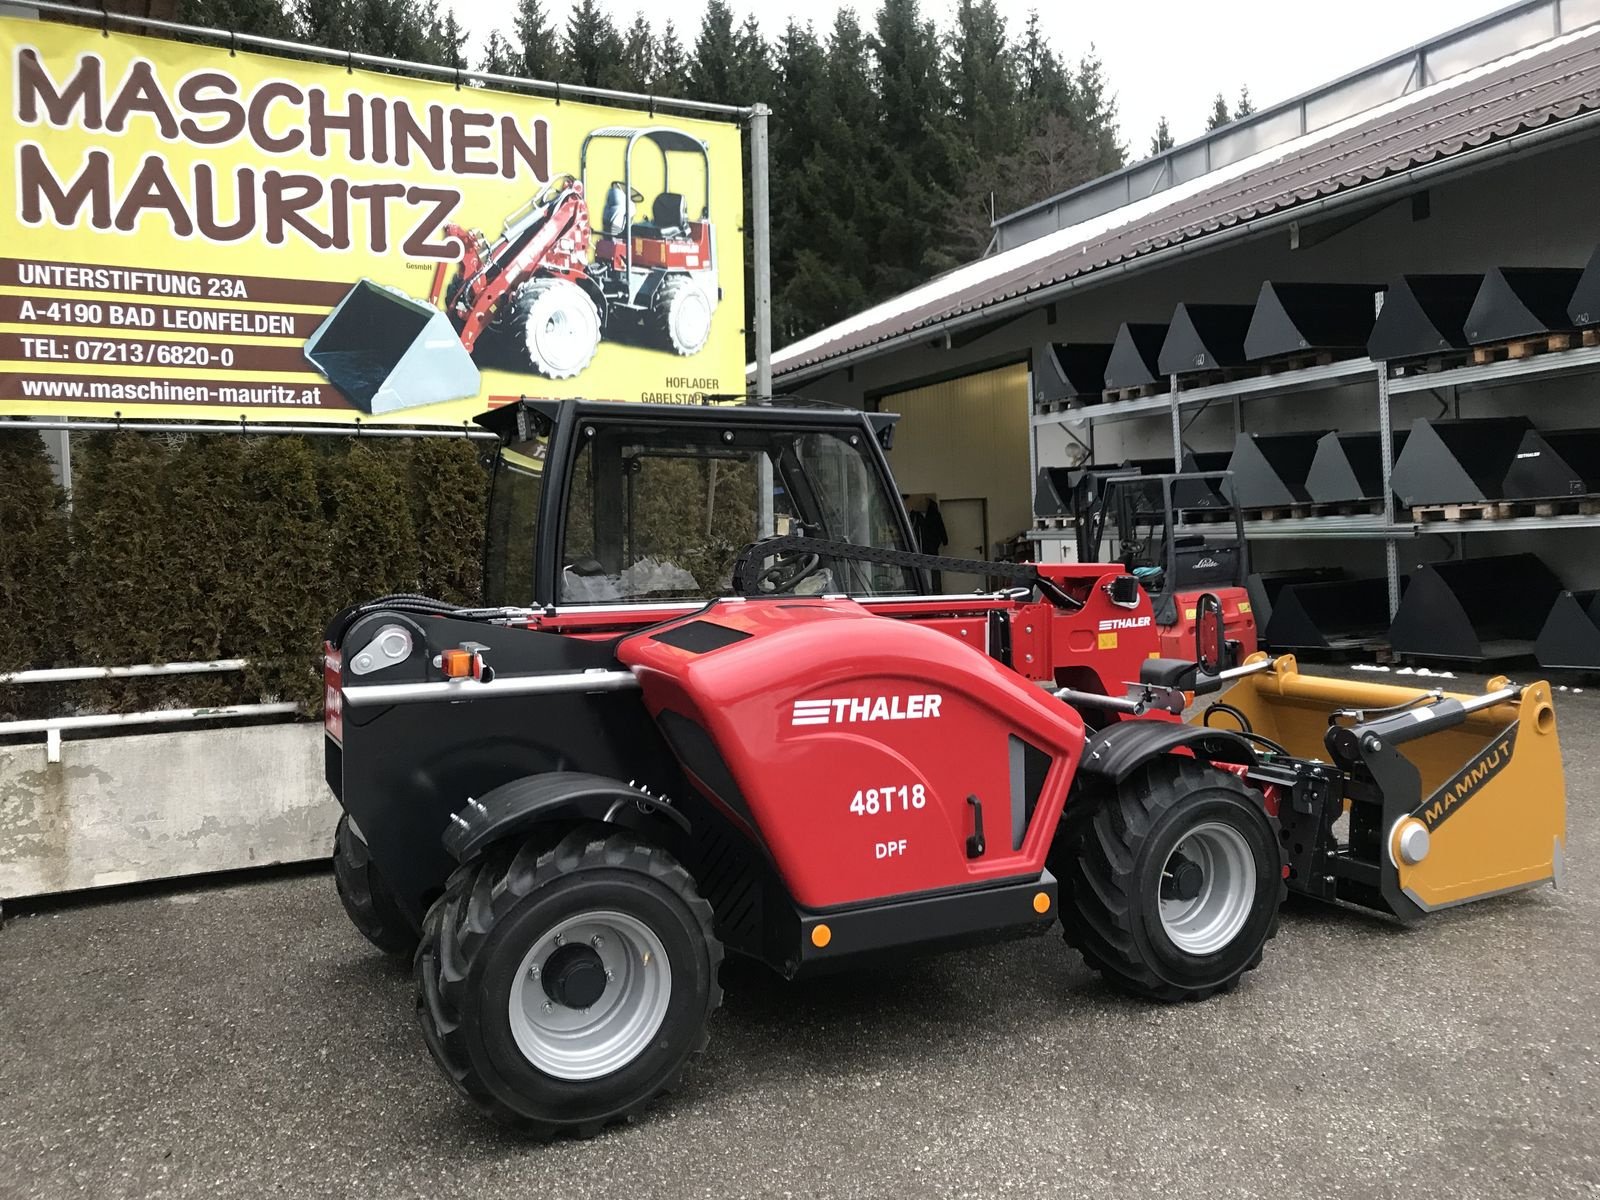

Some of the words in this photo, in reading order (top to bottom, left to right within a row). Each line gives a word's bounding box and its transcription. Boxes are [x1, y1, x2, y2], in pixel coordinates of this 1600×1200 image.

[18, 48, 549, 182] MASCHINEN
[21, 144, 465, 259] MAURITZ
[406, 262, 432, 270] GesmbH
[19, 264, 200, 295] UNTERSTIFTUNG
[208, 278, 248, 298] 23A
[19, 300, 102, 322] A-4190
[109, 306, 155, 326] BAD
[163, 309, 295, 334] LEONFELDEN
[20, 338, 69, 359] TEL:
[22, 380, 321, 405] www.maschinen-mauritz.at
[666, 377, 719, 389] HOFLADER
[1112, 616, 1151, 629] THALER
[831, 694, 942, 723] THALER
[1424, 740, 1510, 825] MAMMUT
[850, 784, 926, 816] 48T18
[875, 839, 908, 859] DPF
